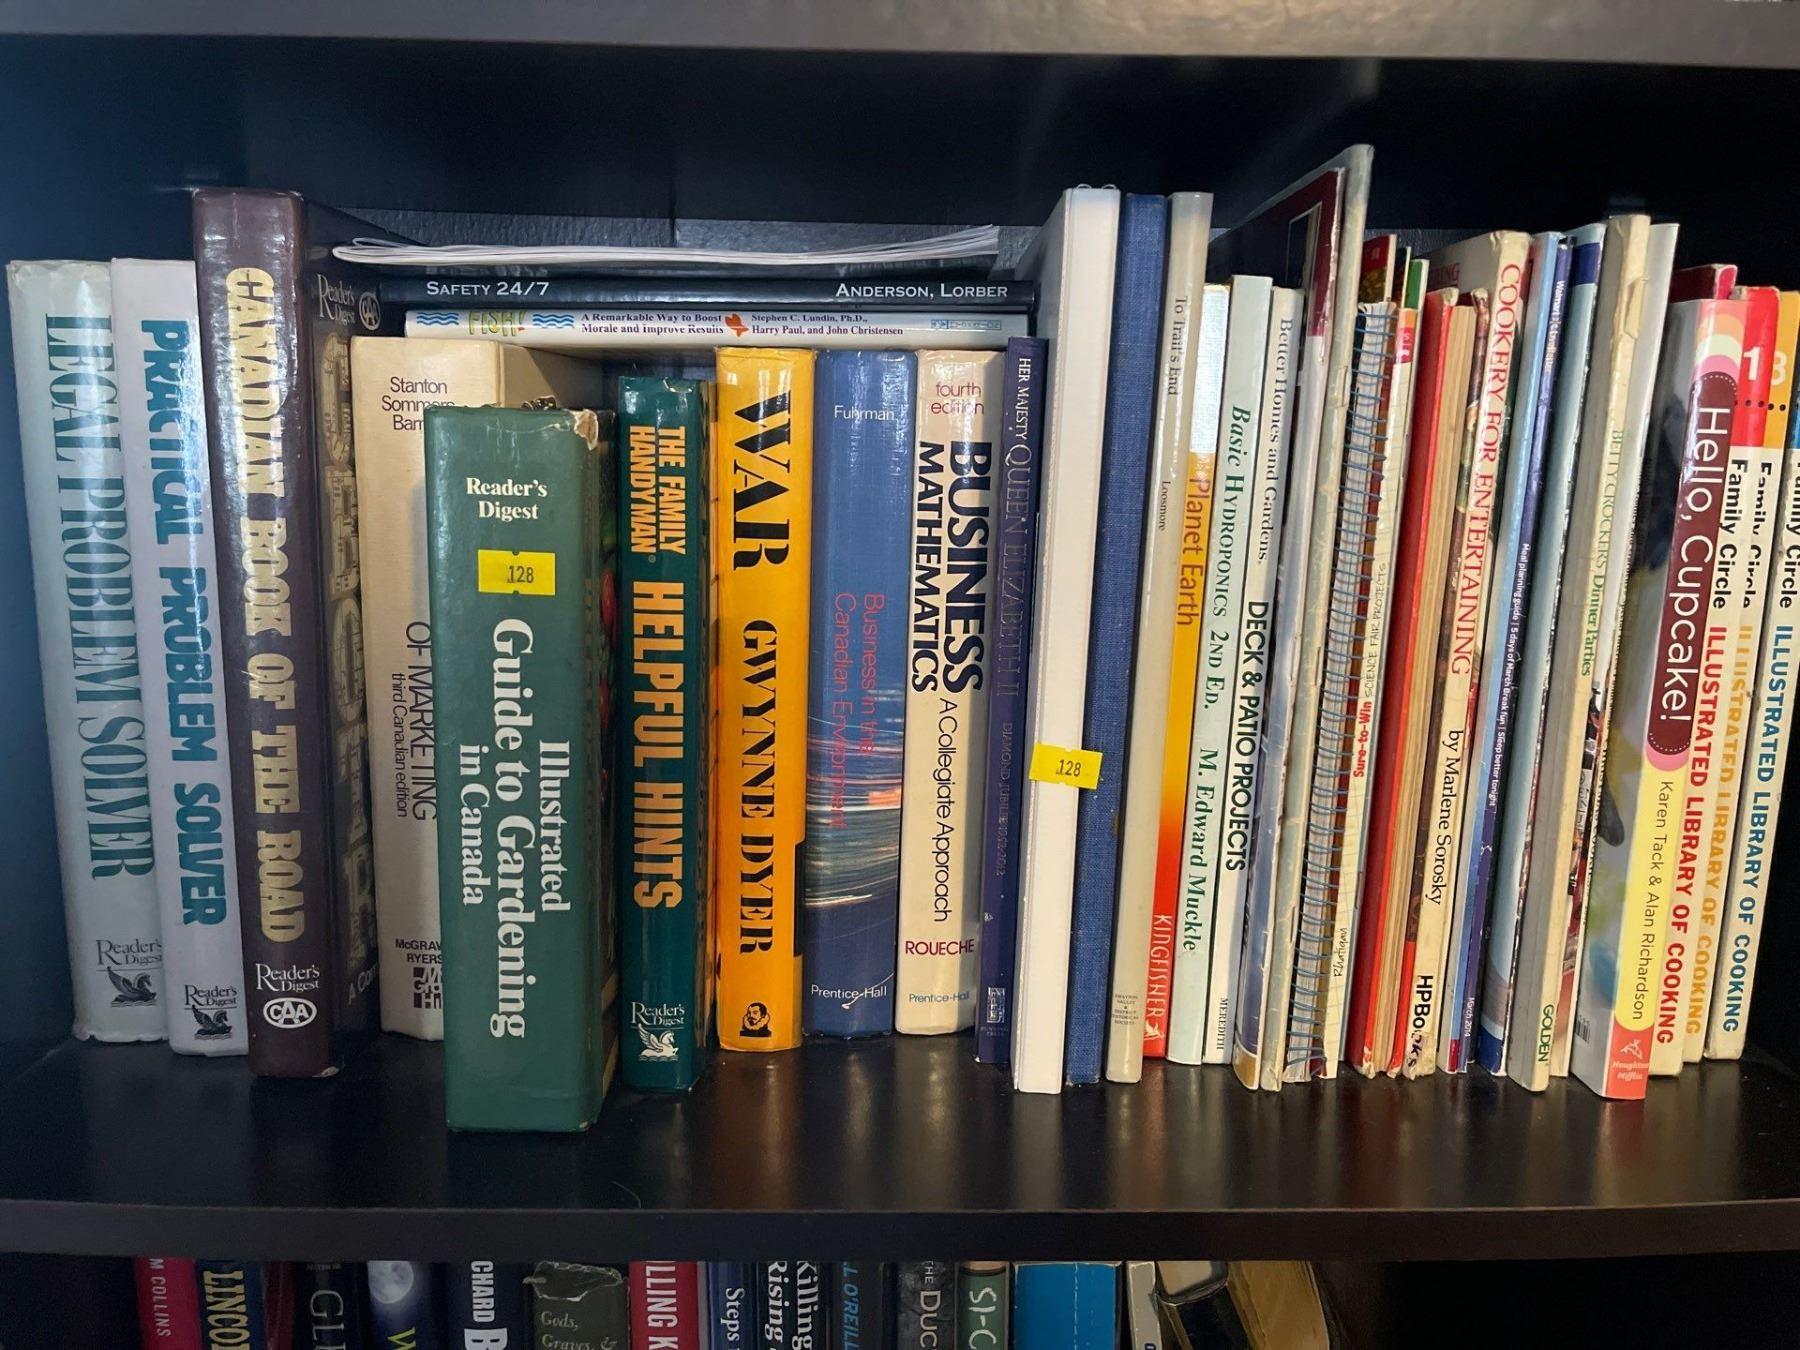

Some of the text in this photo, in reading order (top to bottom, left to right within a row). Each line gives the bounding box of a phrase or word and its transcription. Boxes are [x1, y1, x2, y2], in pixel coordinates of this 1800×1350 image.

[467, 310, 526, 337] FISH!
[496, 281, 550, 297] 24/7
[581, 313, 722, 324] A Remarkable Way to Boost
[751, 314, 868, 324] Stephen C. Lundin, Ph.D.,
[582, 324, 724, 336] Morale and Improve Results
[752, 325, 904, 337] Harry Paul, and John Christensen
[1167, 296, 1189, 396] To Trail's End
[1743, 346, 1761, 380] 1
[390, 376, 448, 394] Stanton
[834, 405, 895, 421] Fuhrman
[930, 400, 985, 416] edition
[936, 381, 982, 398] fourth
[1265, 318, 1294, 481] Better Homes and
[466, 478, 547, 498] Reader's
[478, 501, 538, 522] Digest
[629, 425, 656, 554] HANDYMAN
[658, 425, 686, 555] THE FAMILY
[997, 358, 1032, 674] HER MAJESTY QUEEN ELIZABETH
[1158, 480, 1171, 532] Loosmore
[911, 441, 945, 694] MATHEMATICS
[1176, 477, 1211, 627] Planet Earth
[1424, 262, 1521, 906] COOKERY FOR ENTERTAINING by Marlene Sorosky
[1580, 430, 1624, 677] BETTY Dinner Parties
[1659, 407, 1731, 722] Hello, Cupcake!
[46, 313, 157, 880] LEGAL PROBLEM SOLVER
[141, 319, 226, 927] PRACTICAL PROBLEM SOLVER
[226, 267, 305, 943] CANADIAN BOOK OF THE ROAD
[733, 390, 791, 955] WAR GWYNNE DYER
[860, 593, 885, 715] Business in
[931, 441, 993, 923] BUSINESS A Collegiate Approach
[1182, 405, 1251, 952] Basic HYDROPONICS M. Edward Muckle
[1488, 543, 1530, 807] Meal planning guide days March Break Sleep better tonight
[391, 672, 408, 818] third Canadian edition
[633, 581, 685, 909] HELPFUL HINTS
[830, 592, 857, 829] Canadian Environment
[1225, 600, 1268, 872] DECK & PATIO PROJECTS
[1353, 650, 1378, 778] Sure-to-Win SCIENCE
[1655, 459, 1749, 1045] Family Circle ILLUSTRATED LIBRARY OF COOKING
[1724, 544, 1800, 1033] Circle ILLUSTRATED LIBRARY OF COOKING
[460, 744, 491, 906] in Canada
[490, 618, 536, 1039] Guide to Gardening
[539, 740, 571, 912] Illustrated
[1632, 781, 1674, 1021] Karen Tack & Alan Richardson
[96, 938, 163, 966] Reader's
[125, 953, 162, 966] Digest
[256, 963, 320, 992] Reader's
[905, 938, 974, 956] ROUECHE
[1143, 914, 1173, 1021] KINGFISHER
[1333, 927, 1349, 977] Rhatigan
[184, 984, 238, 1007] Reader's
[206, 996, 237, 1007] Digest
[270, 1000, 310, 1024] CAA
[281, 980, 319, 993] Digest
[631, 1001, 685, 1027] Reader's
[811, 985, 887, 1000] Prentice-Hall
[909, 991, 971, 1004] Prentice-Hall
[1464, 997, 1475, 1037] March 2014
[1685, 934, 1713, 1035] COOKING
[652, 1015, 685, 1027] Digest
[1216, 997, 1229, 1050] MEREDITH
[1537, 1004, 1555, 1063] GOLDEN
[151, 1276, 171, 1338] COLLINS
[541, 1311, 579, 1331] Gods,
[720, 1287, 746, 1342] Steps
[764, 1261, 790, 1343] Rising
[792, 1261, 819, 1350] Killing
